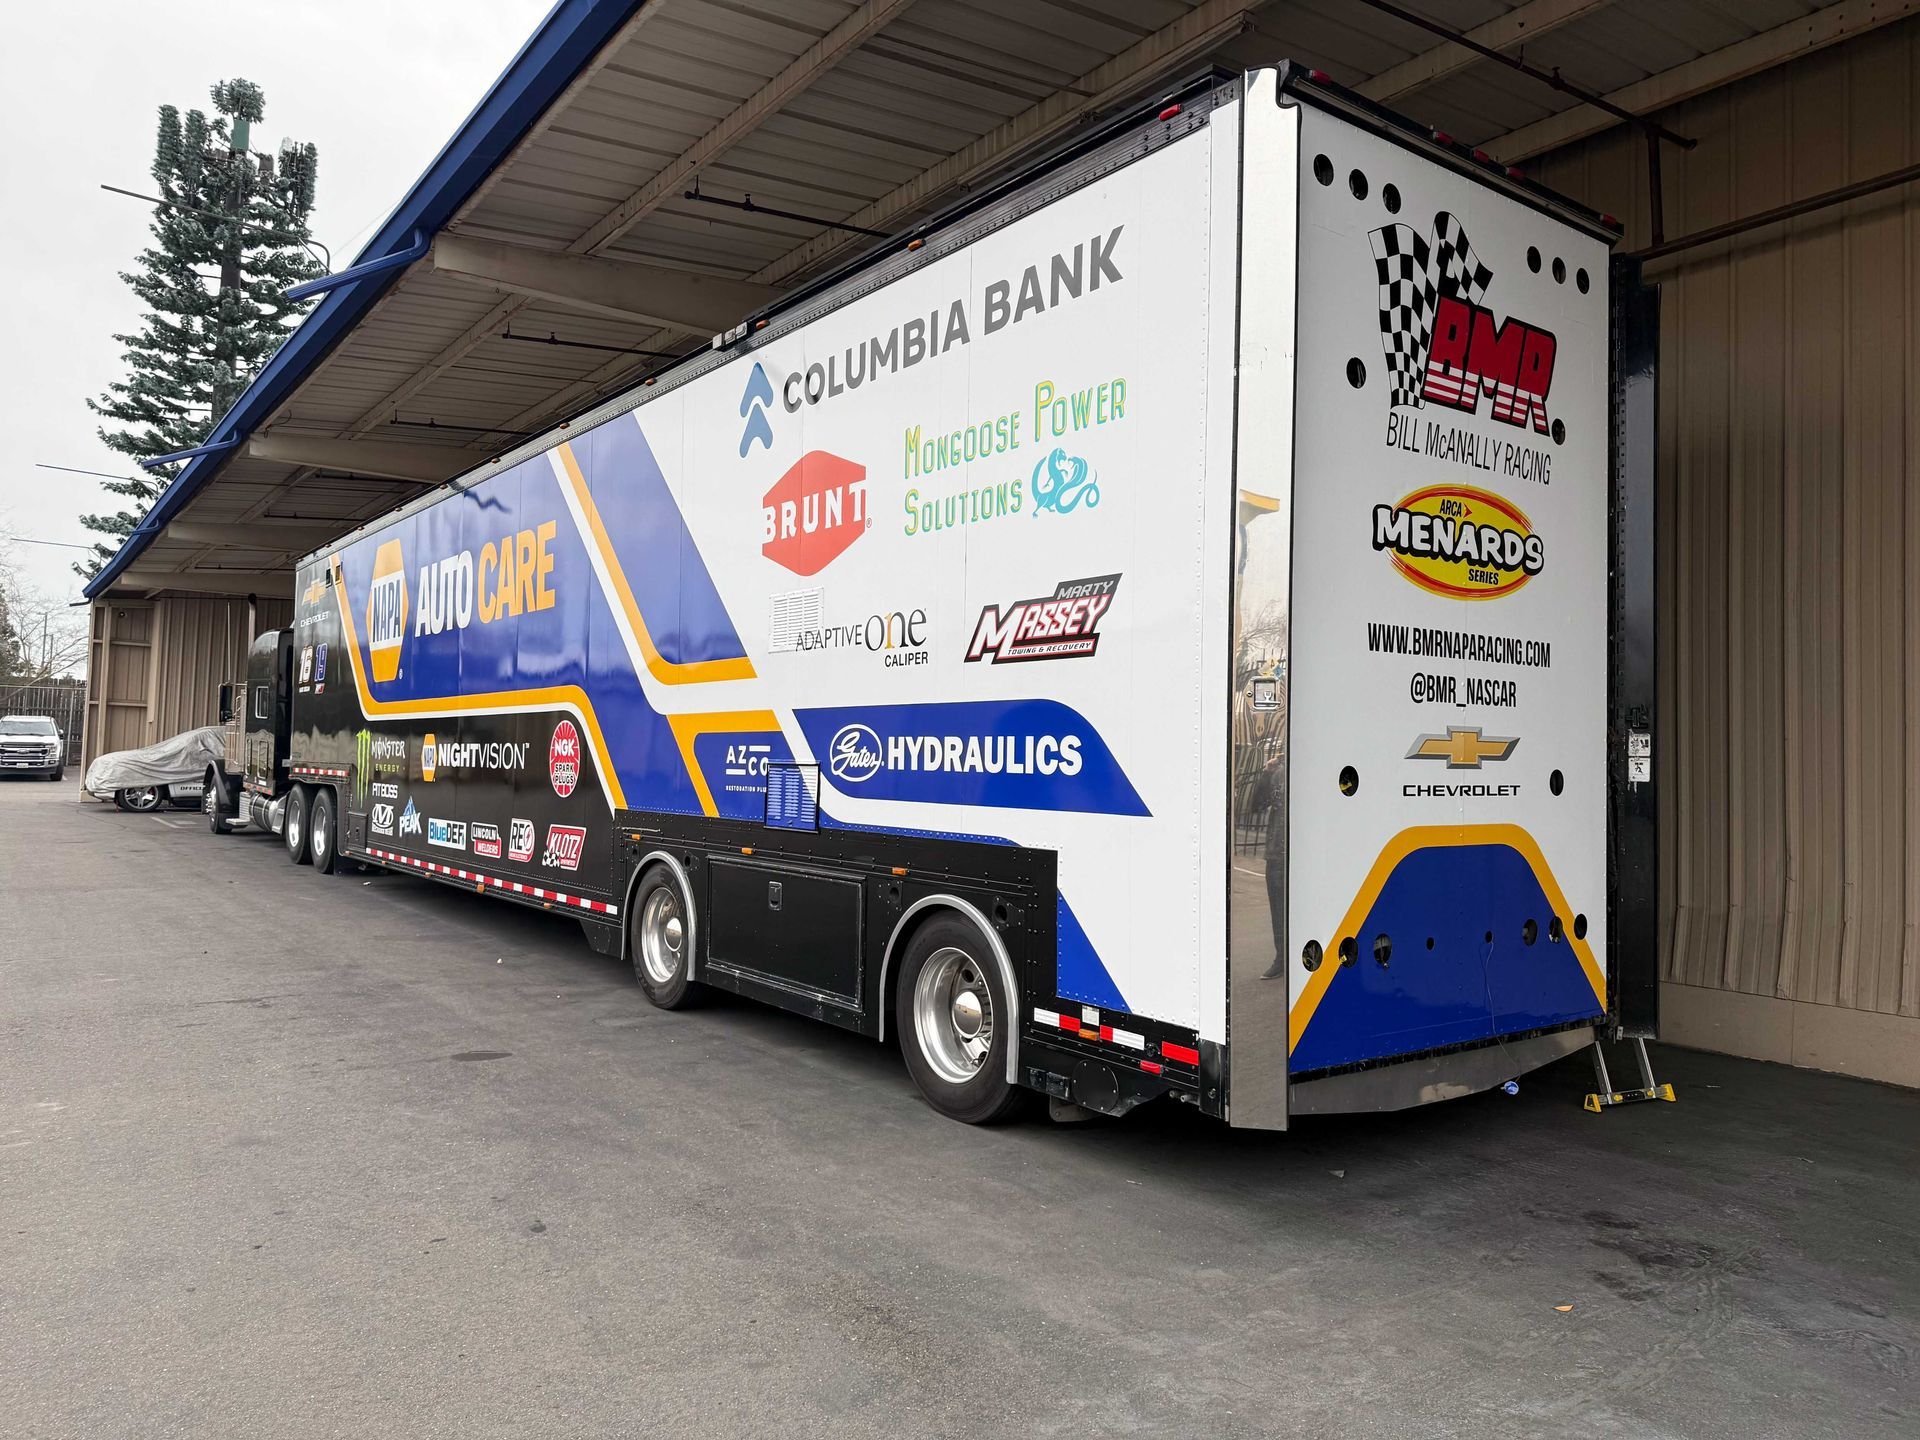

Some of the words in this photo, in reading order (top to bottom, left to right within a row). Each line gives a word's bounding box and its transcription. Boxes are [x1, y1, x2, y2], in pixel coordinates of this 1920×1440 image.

[783, 299, 970, 414] COLUMBIA
[984, 224, 1125, 336] BANK
[1421, 295, 1557, 437] BMR
[1386, 411, 1420, 454] BILL
[1425, 422, 1503, 472] McANALLY
[1504, 443, 1552, 485] RACING
[762, 479, 867, 544] BRUNT
[1439, 499, 1462, 518] ARCA
[1372, 504, 1544, 576] MENARDS
[372, 579, 401, 643] NAPA
[415, 550, 474, 638] AUTO
[478, 520, 556, 624] CARE
[1468, 569, 1499, 585] SERIES
[1057, 580, 1114, 600] MARTY
[795, 625, 863, 652] ADAPTIVE
[968, 596, 1108, 659] MASSEY
[1007, 646, 1036, 656] TOWING
[1046, 643, 1092, 653] RECOVERY
[1367, 622, 1551, 669] WWW.BMRNAPARACING.COM
[885, 651, 929, 667] CALIPER
[1409, 671, 1517, 710] @BMR_NASCAR
[371, 737, 406, 760] MONSTER
[554, 738, 575, 757] NGK
[837, 730, 880, 770] Gates
[888, 734, 1082, 776] HYDRAULICS
[375, 764, 400, 773] ENERGY
[555, 763, 574, 773] SPARK
[555, 774, 574, 785] PLUGS
[1402, 782, 1521, 798] CHEVROLET
[399, 812, 422, 838] PEAK
[472, 825, 496, 841] LINCOLN
[477, 842, 498, 855] WELDERS
[549, 832, 581, 859] KLOTZ
